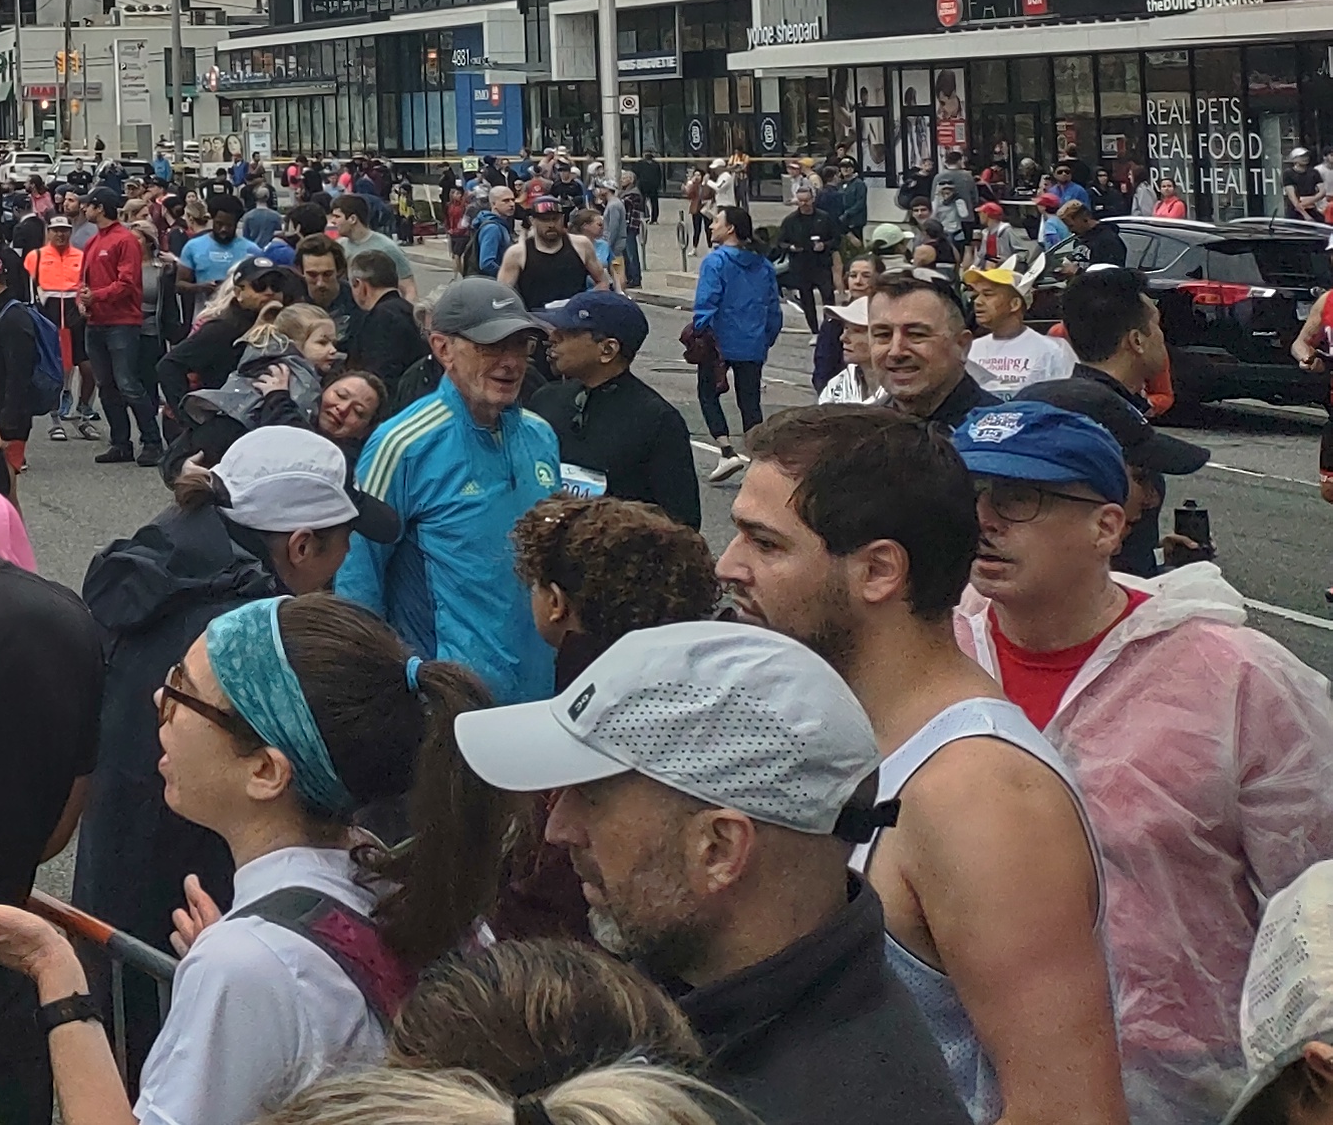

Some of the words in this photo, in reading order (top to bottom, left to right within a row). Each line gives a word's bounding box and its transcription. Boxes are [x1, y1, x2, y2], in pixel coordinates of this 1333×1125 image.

[746, 25, 774, 50] yonge
[775, 16, 821, 45] sheppard
[1146, 98, 1191, 125] REAL
[1147, 133, 1193, 159] REAL
[1198, 132, 1269, 160] FOOD.
